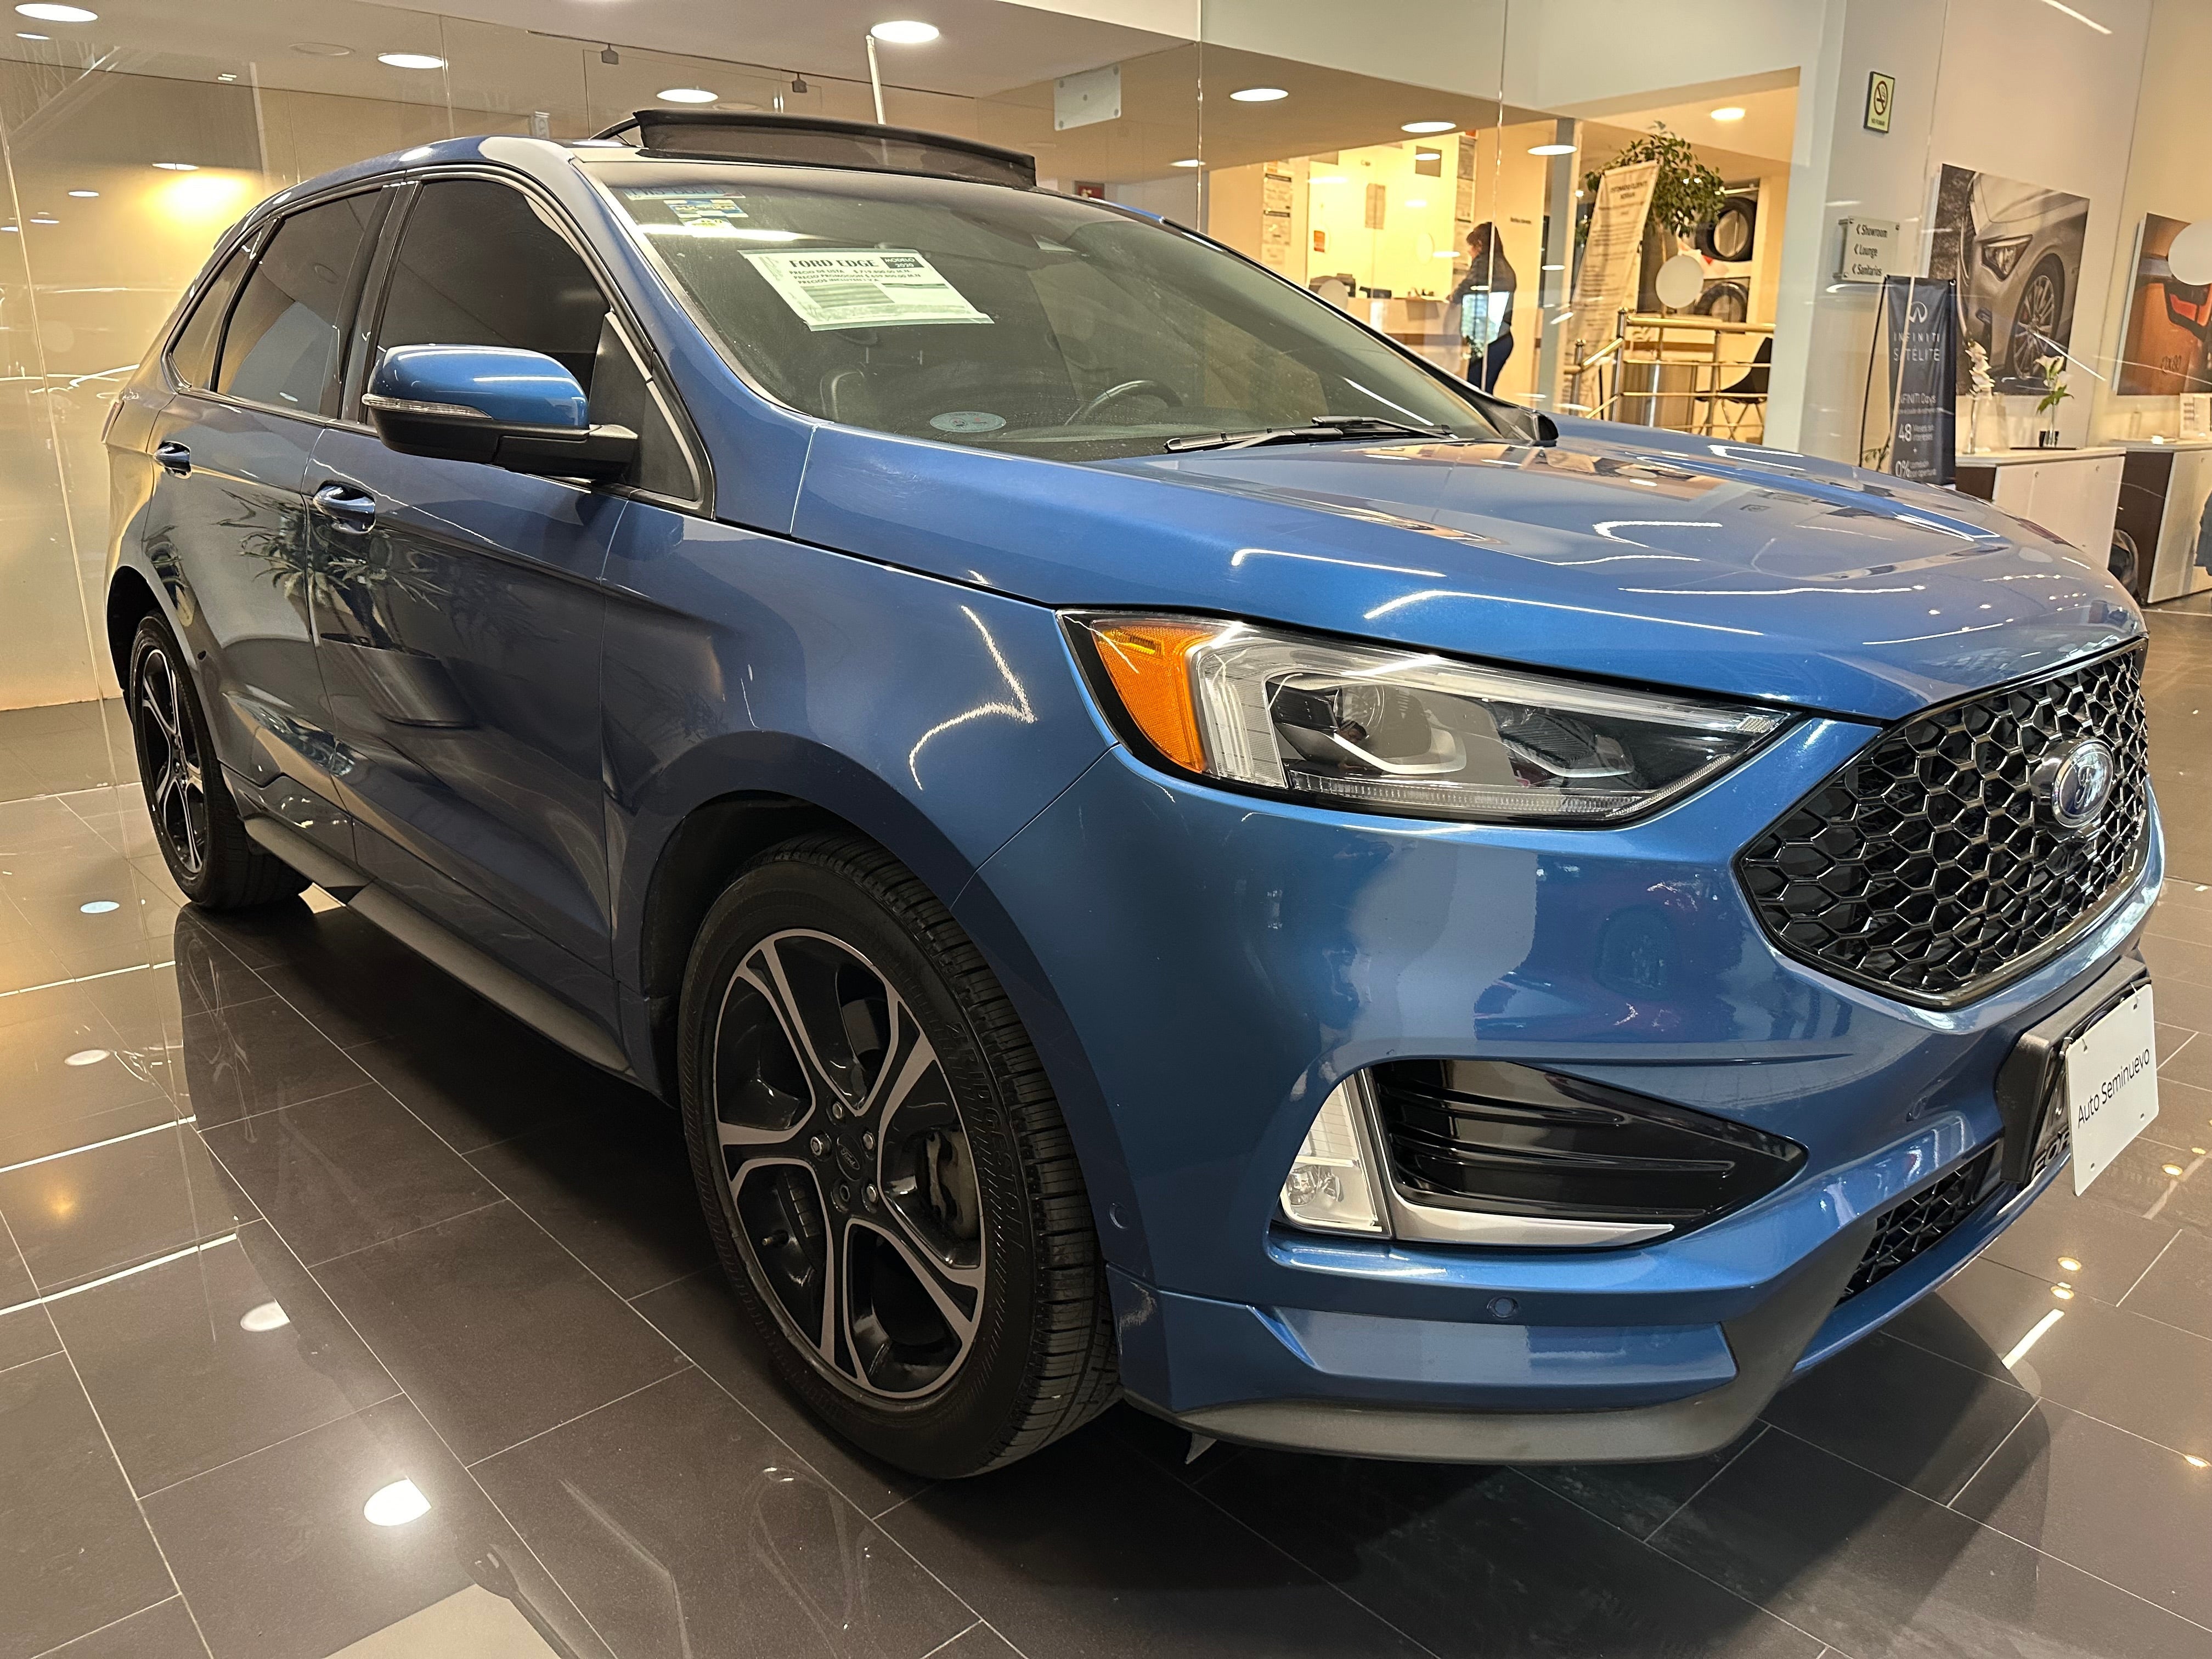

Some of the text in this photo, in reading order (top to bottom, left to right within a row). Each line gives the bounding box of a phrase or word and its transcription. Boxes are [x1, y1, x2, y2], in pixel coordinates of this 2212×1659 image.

[1861, 224, 1887, 238] Showroom
[1859, 244, 1878, 259] Lounge
[1857, 264, 1882, 276] Sanitarios
[1894, 332, 1940, 342] INFINITI
[1893, 345, 1940, 361] STÉLITE
[1898, 423, 1912, 442] 48
[1895, 460, 1910, 478] 0%
[2078, 1048, 2150, 1129] Auto Seminuevo
[840, 1147, 856, 1167] Ford
